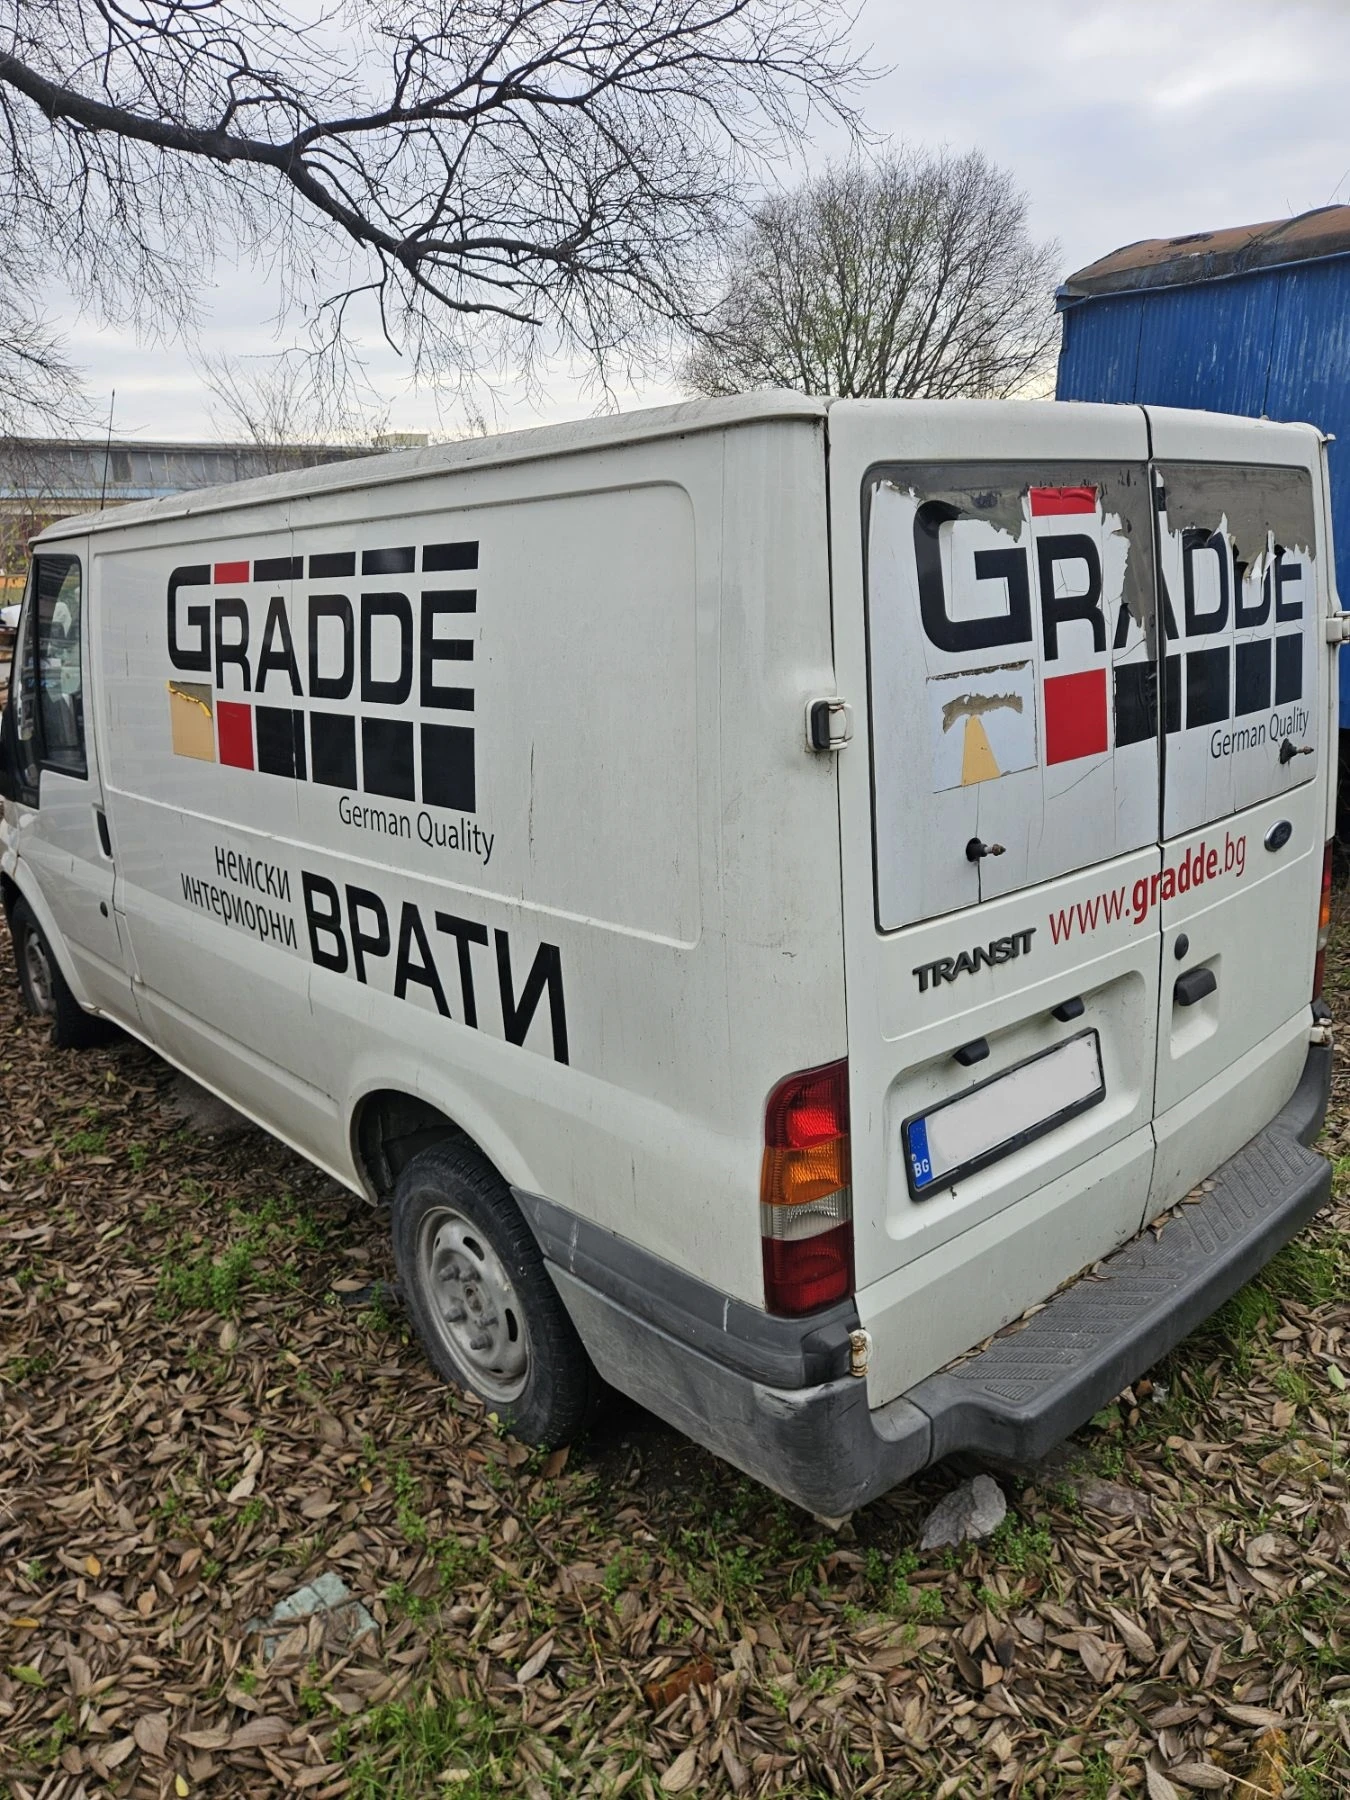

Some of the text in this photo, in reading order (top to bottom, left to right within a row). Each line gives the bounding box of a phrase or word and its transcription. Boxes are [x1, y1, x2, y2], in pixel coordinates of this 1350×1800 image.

[167, 563, 478, 712] GRADDE
[1210, 706, 1310, 760] German Quality
[338, 795, 495, 866] German Quality
[214, 844, 292, 903] немски
[1048, 831, 1247, 946] www.gradde.bg
[180, 869, 570, 1067] интериорни ВРАТИ
[911, 926, 1037, 993] TRANSIT
[913, 1158, 930, 1178] BG
